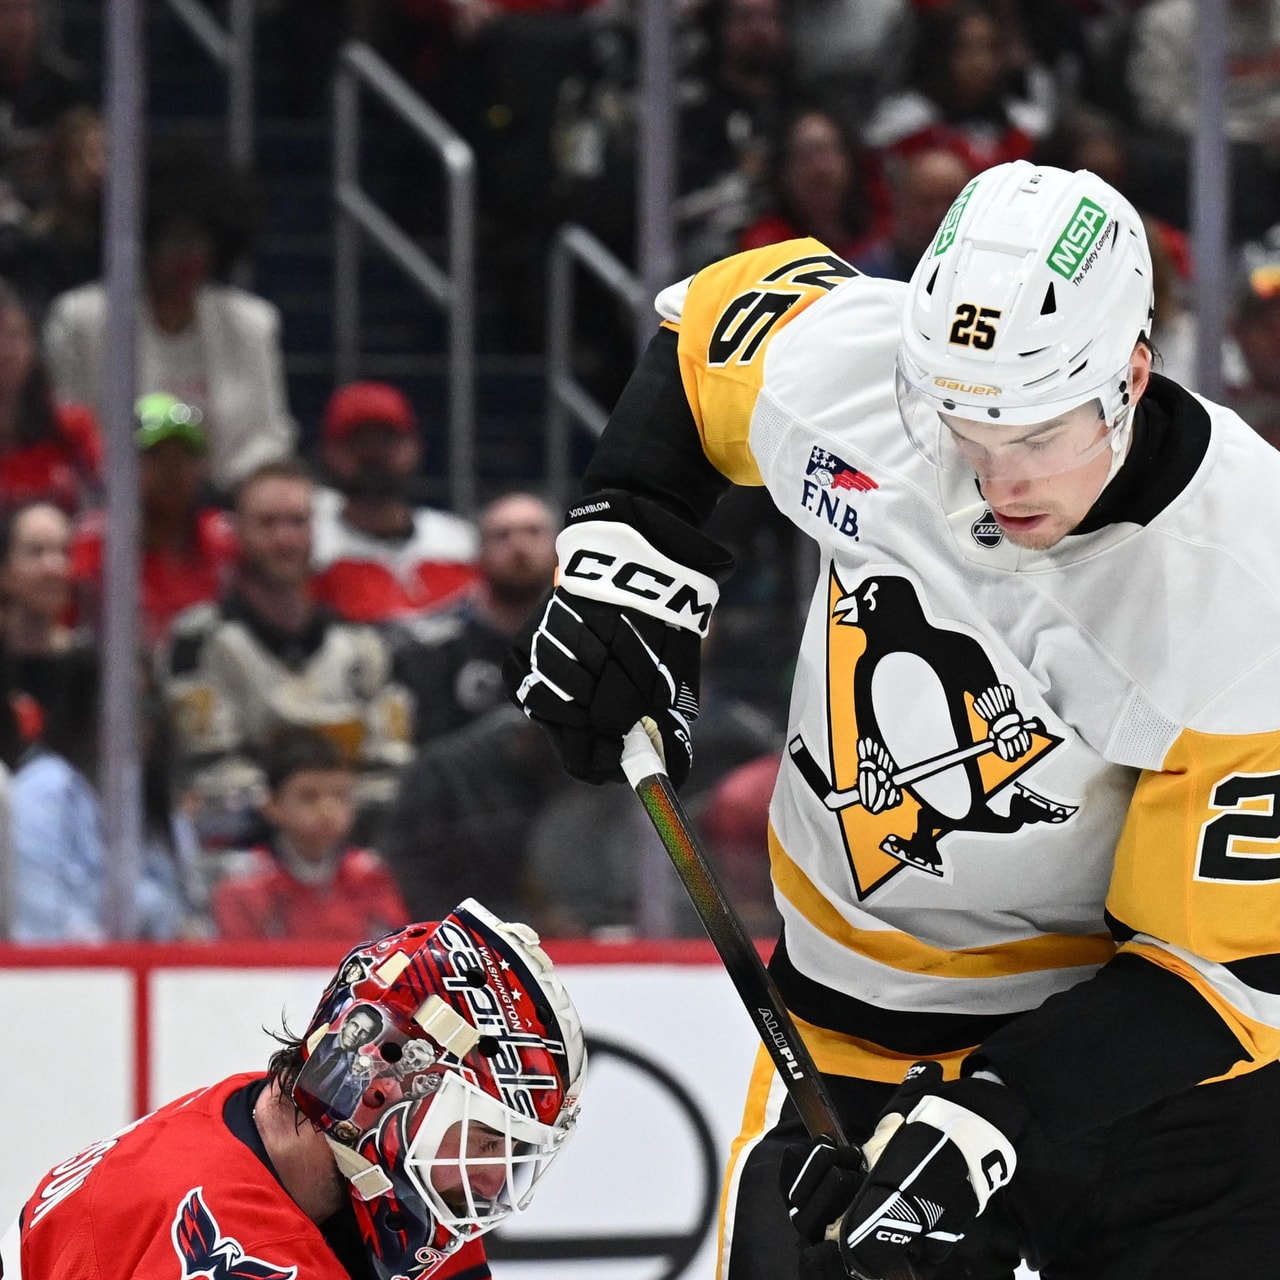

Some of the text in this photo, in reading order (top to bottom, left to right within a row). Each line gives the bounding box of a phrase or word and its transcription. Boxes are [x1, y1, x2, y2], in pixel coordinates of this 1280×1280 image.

[1051, 203, 1105, 276] MSA
[1072, 272, 1084, 287] The
[1081, 249, 1098, 274] Safety
[949, 303, 1001, 350] 25
[800, 479, 860, 542] F.N.B.
[564, 548, 714, 633] CCM
[477, 945, 524, 1031] WASHINGTON
